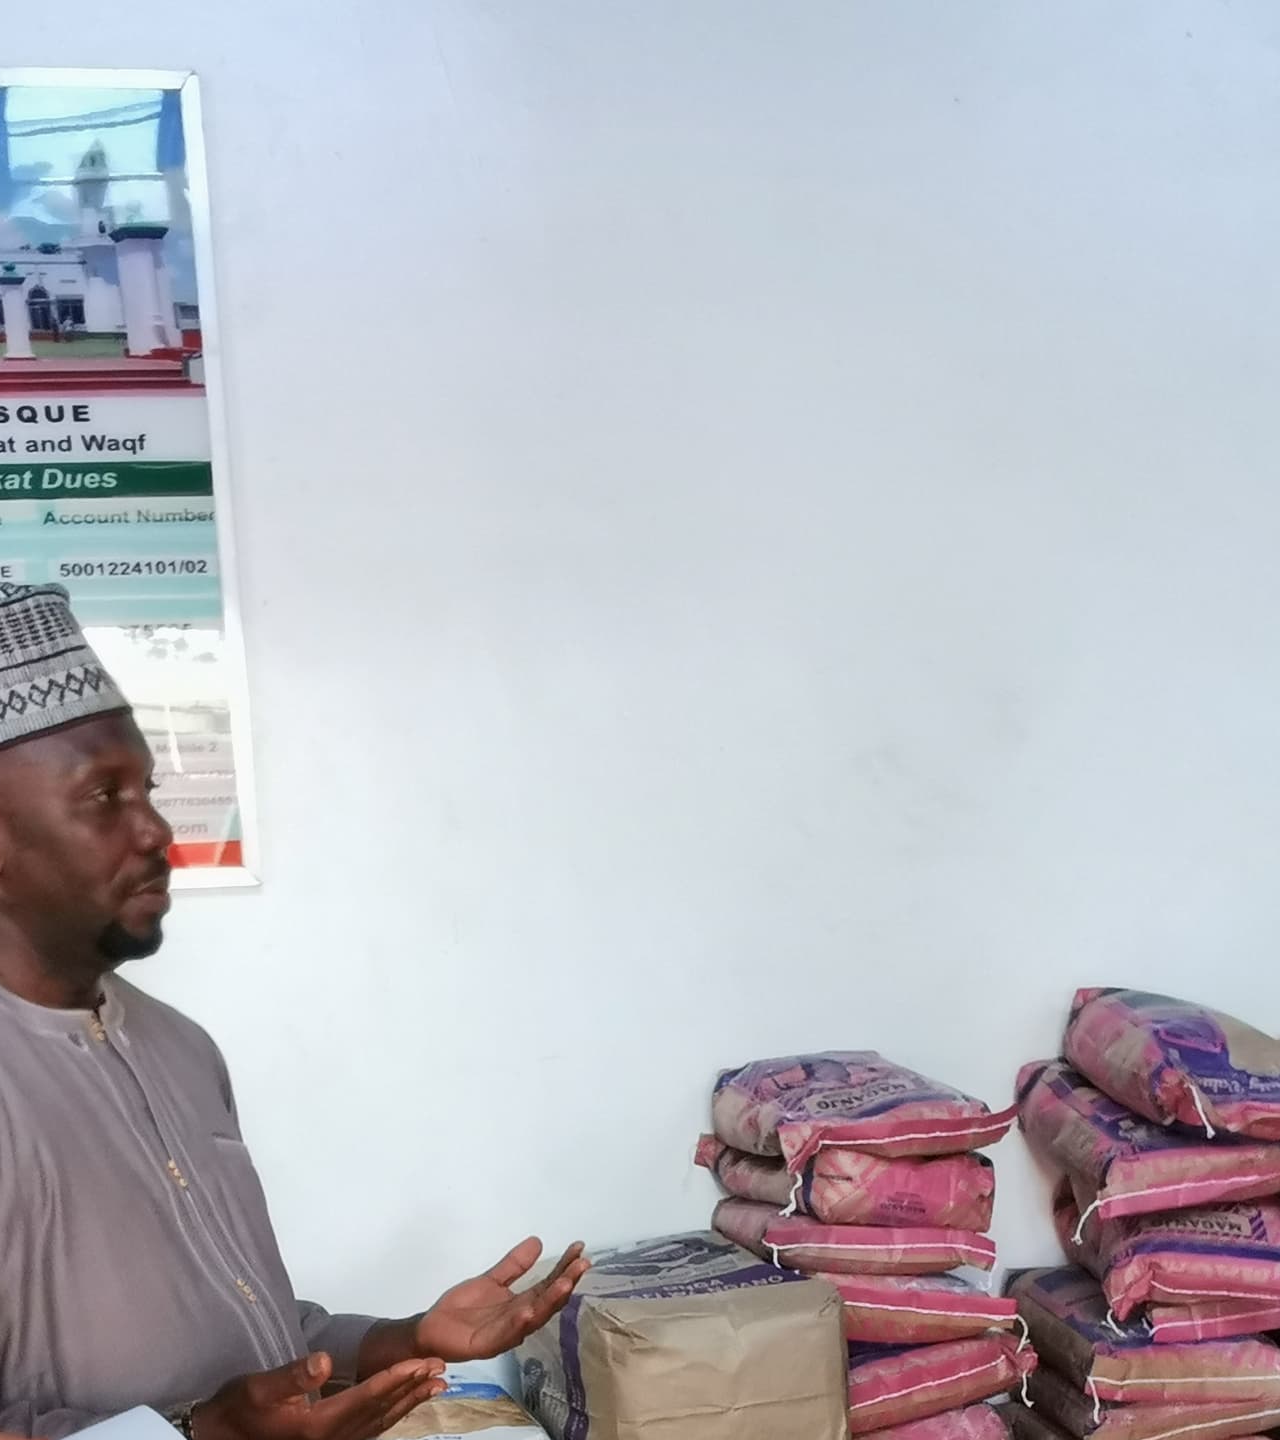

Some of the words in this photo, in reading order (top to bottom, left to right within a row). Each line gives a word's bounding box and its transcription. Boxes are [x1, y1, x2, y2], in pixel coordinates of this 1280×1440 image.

[25, 434, 73, 453] and
[81, 433, 147, 455] Waqf
[41, 468, 118, 490] Dues
[43, 509, 130, 526] Account
[59, 559, 208, 577] 5001224101/02
